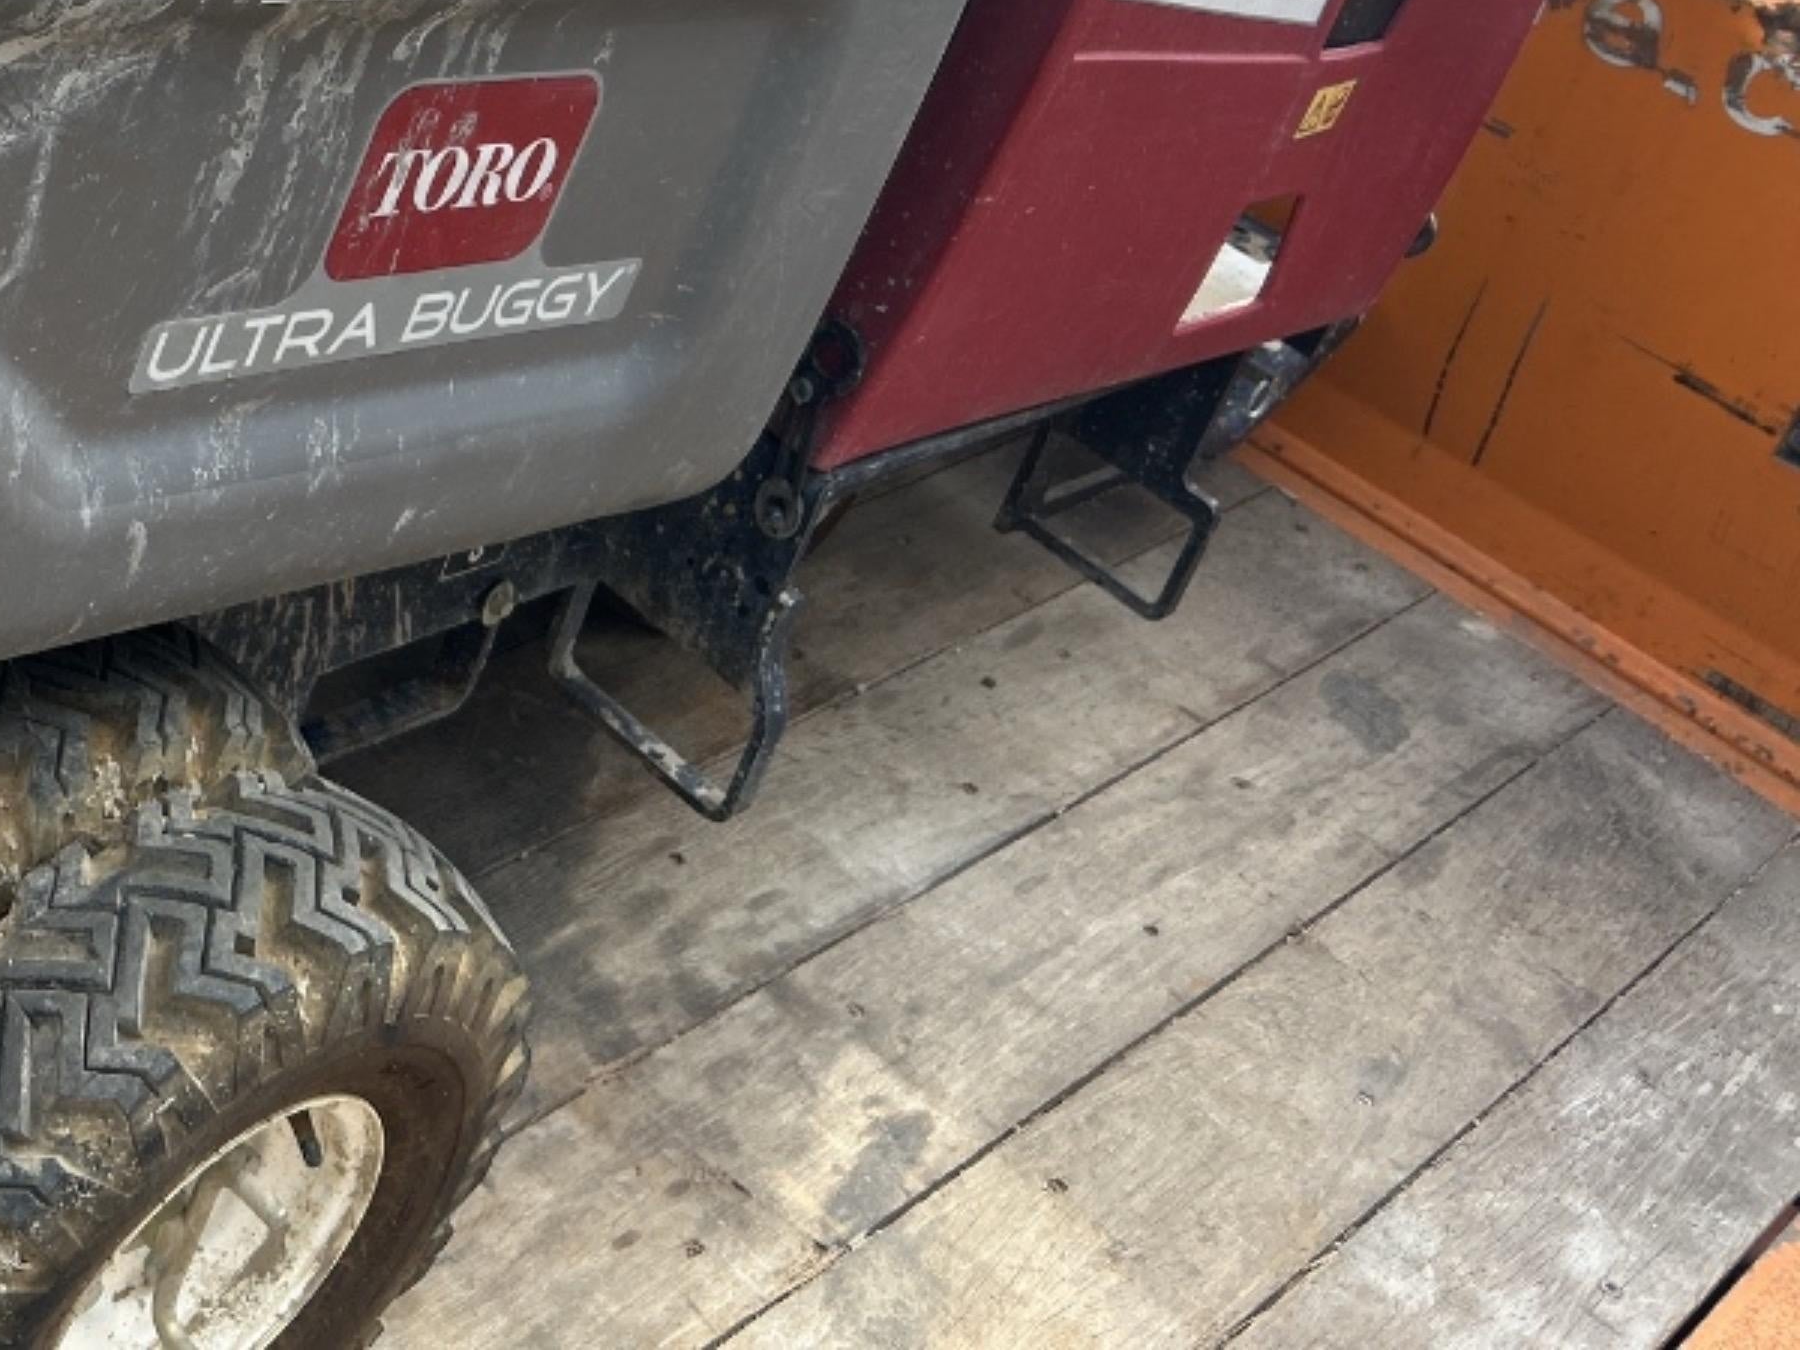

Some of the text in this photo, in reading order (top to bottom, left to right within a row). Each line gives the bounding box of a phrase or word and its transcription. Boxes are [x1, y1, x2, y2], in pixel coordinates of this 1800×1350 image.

[368, 136, 559, 218] TORO
[145, 265, 625, 381] ULTRA BUGGY
